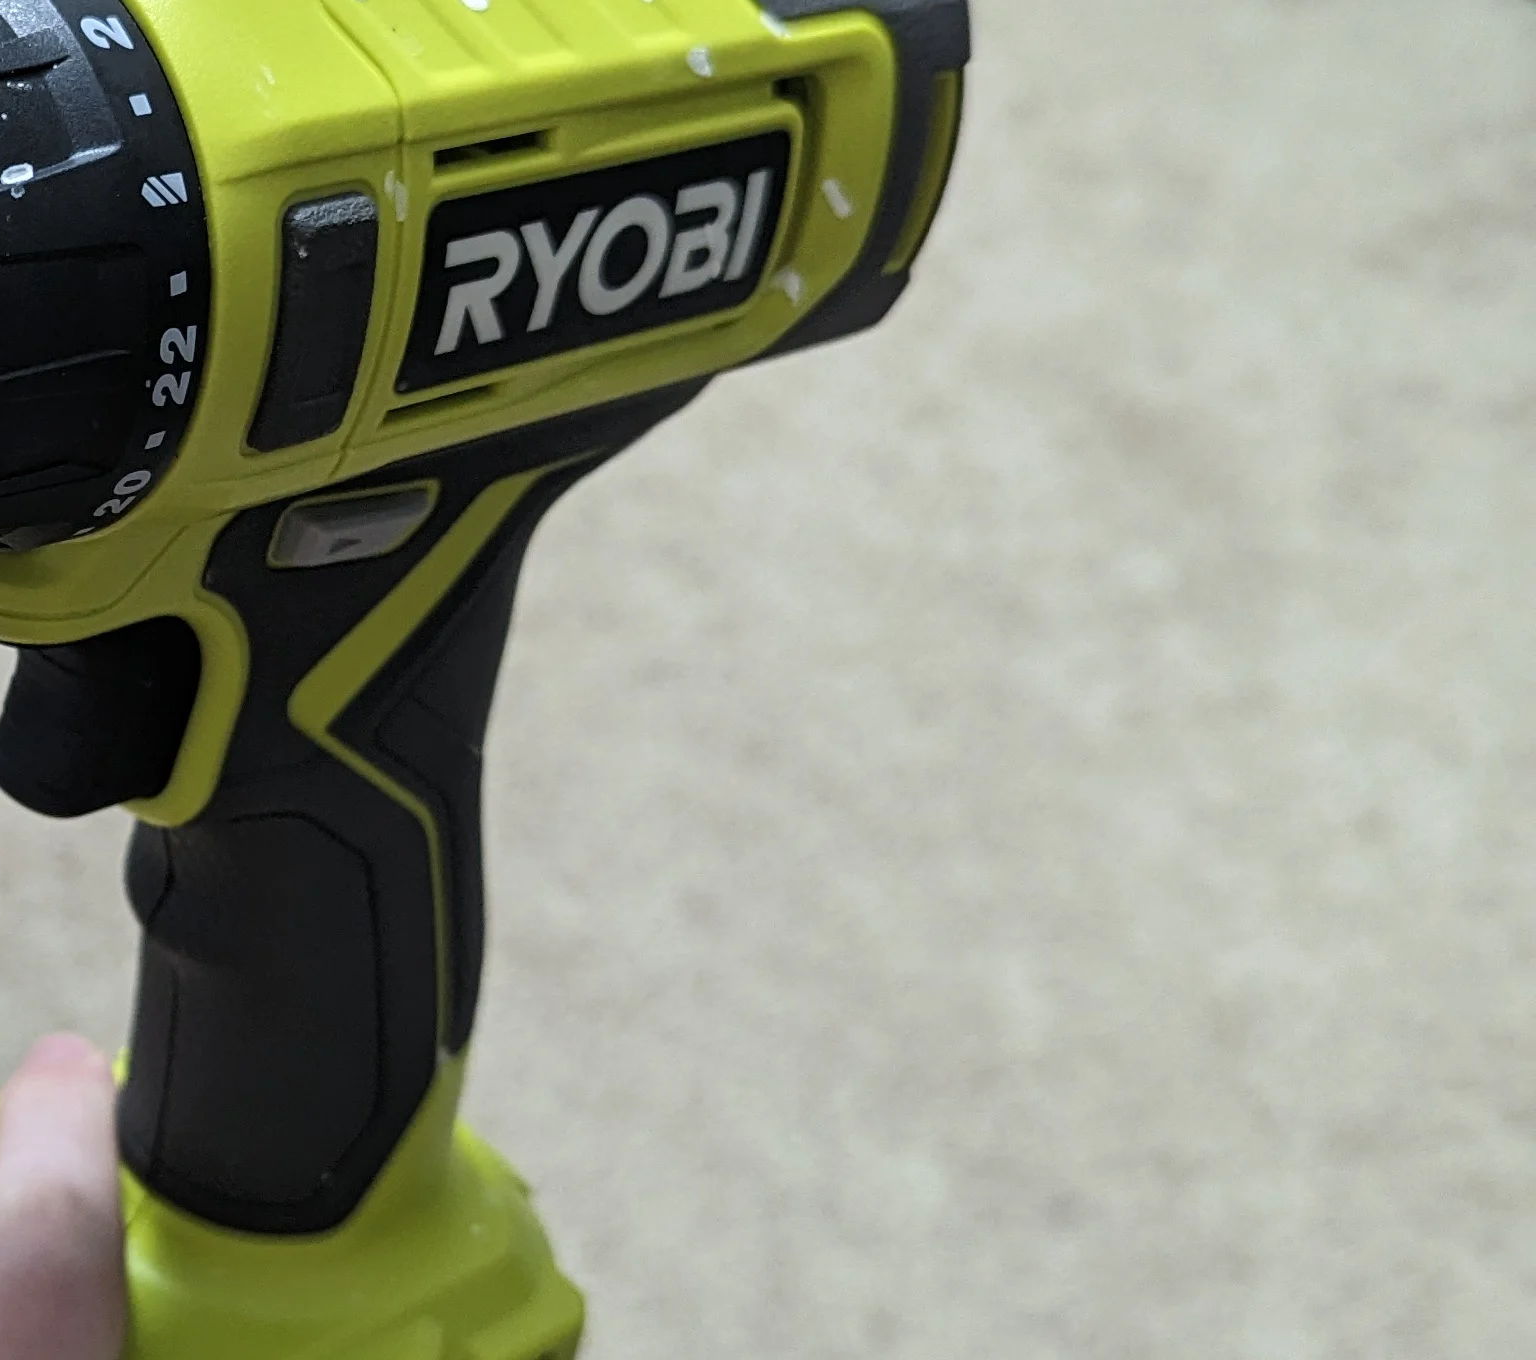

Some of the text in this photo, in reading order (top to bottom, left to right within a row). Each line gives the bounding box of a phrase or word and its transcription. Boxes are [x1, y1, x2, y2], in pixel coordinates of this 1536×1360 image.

[80, 15, 135, 50] 2
[434, 168, 773, 355] RYOBI
[152, 324, 198, 407] 22
[92, 469, 153, 518] 20
